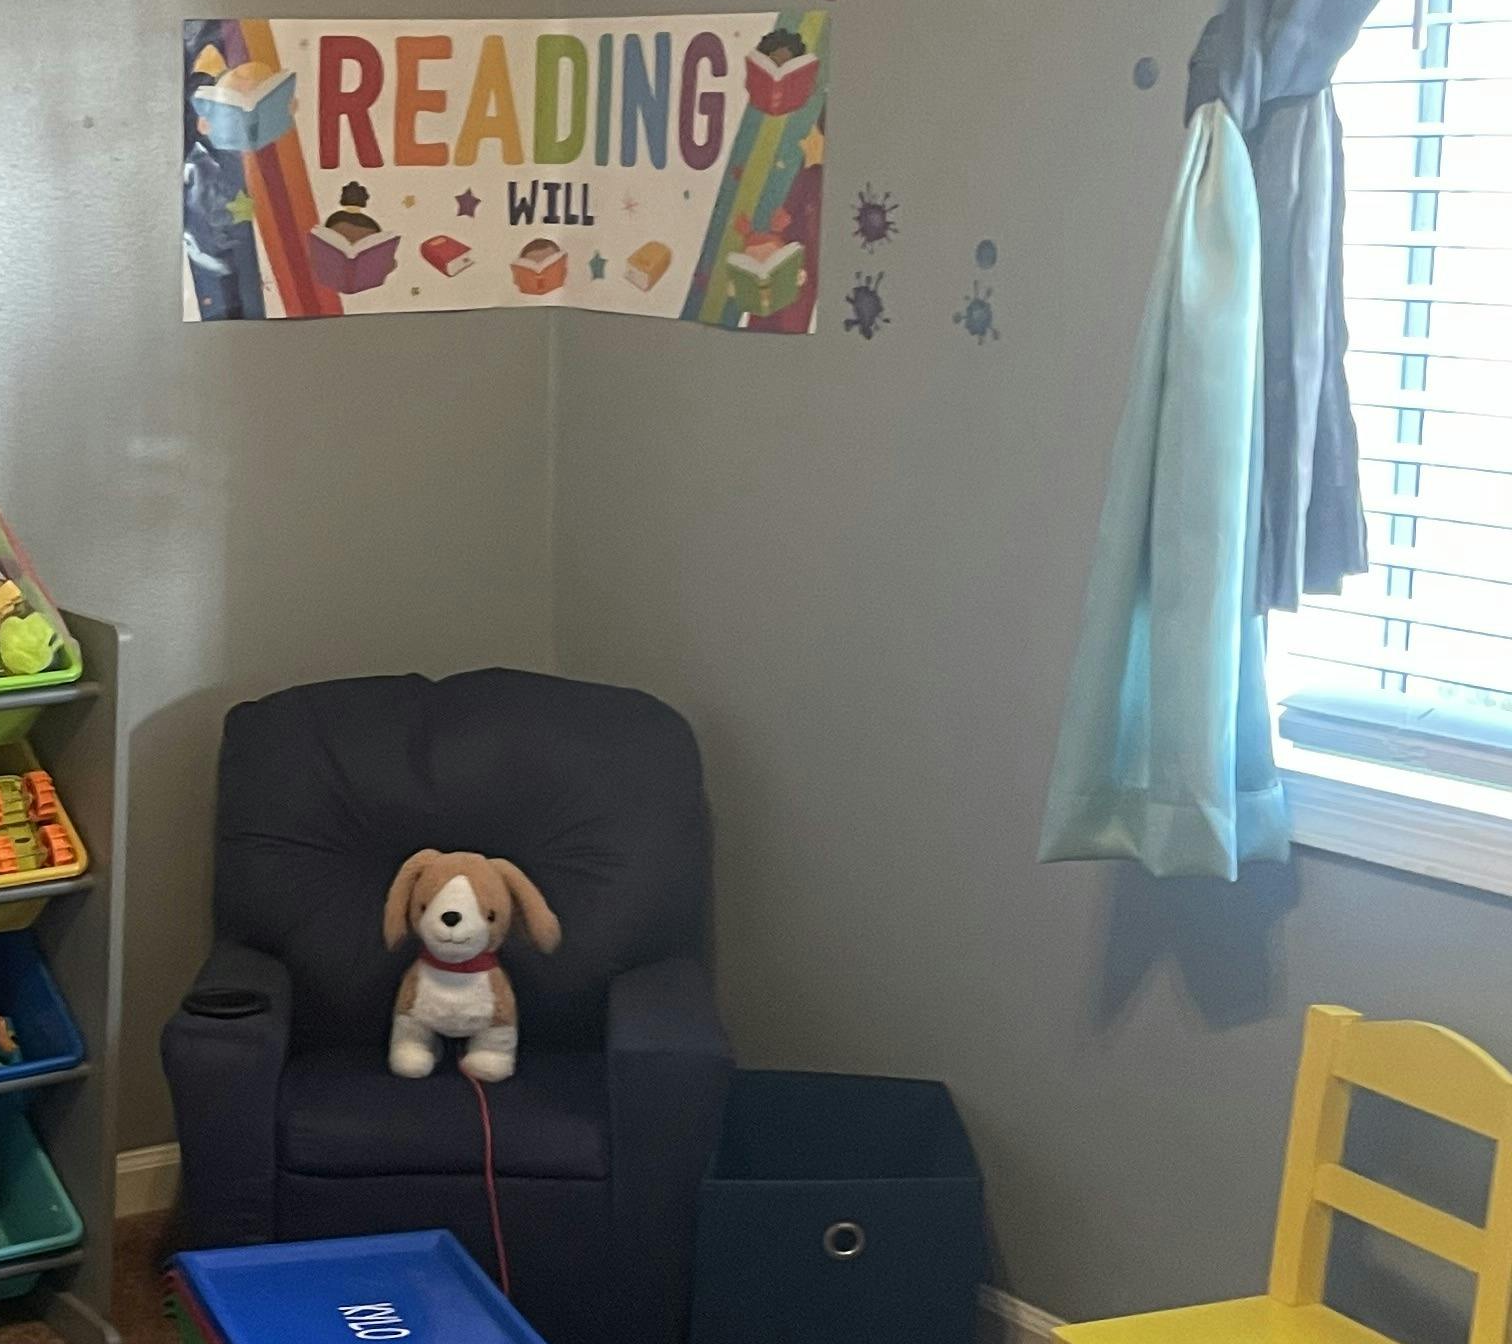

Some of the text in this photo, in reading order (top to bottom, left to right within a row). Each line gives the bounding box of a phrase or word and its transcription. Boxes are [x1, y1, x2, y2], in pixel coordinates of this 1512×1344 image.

[318, 32, 728, 170] READING
[507, 179, 596, 226] WILL
[336, 1302, 411, 1340] KYLO
